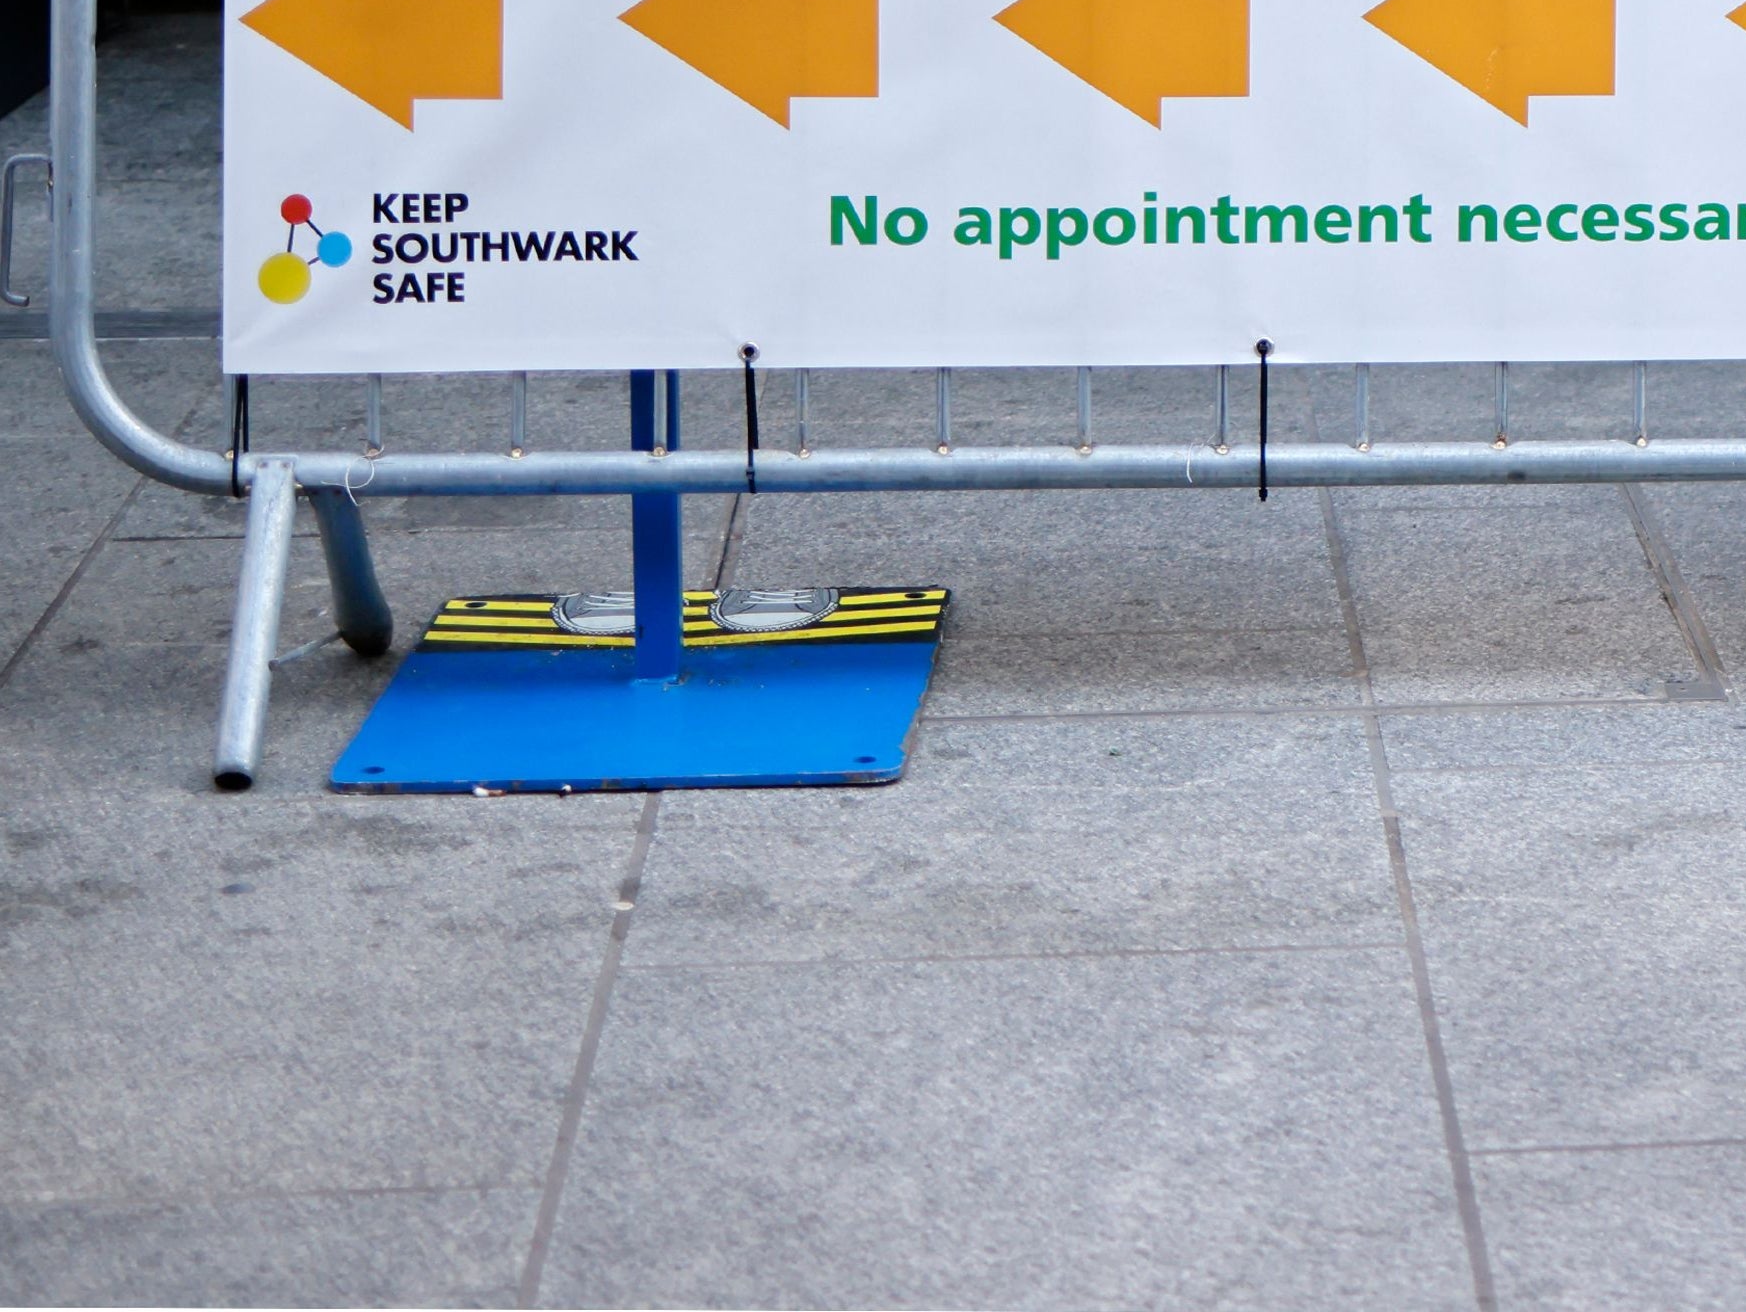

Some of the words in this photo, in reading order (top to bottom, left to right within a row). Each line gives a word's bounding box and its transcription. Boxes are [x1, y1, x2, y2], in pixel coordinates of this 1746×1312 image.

[372, 192, 470, 225] KEEP
[830, 196, 930, 248] No
[954, 192, 1434, 262] appointment
[371, 230, 640, 266] SOUTHWARK
[372, 272, 466, 306] SAFE
